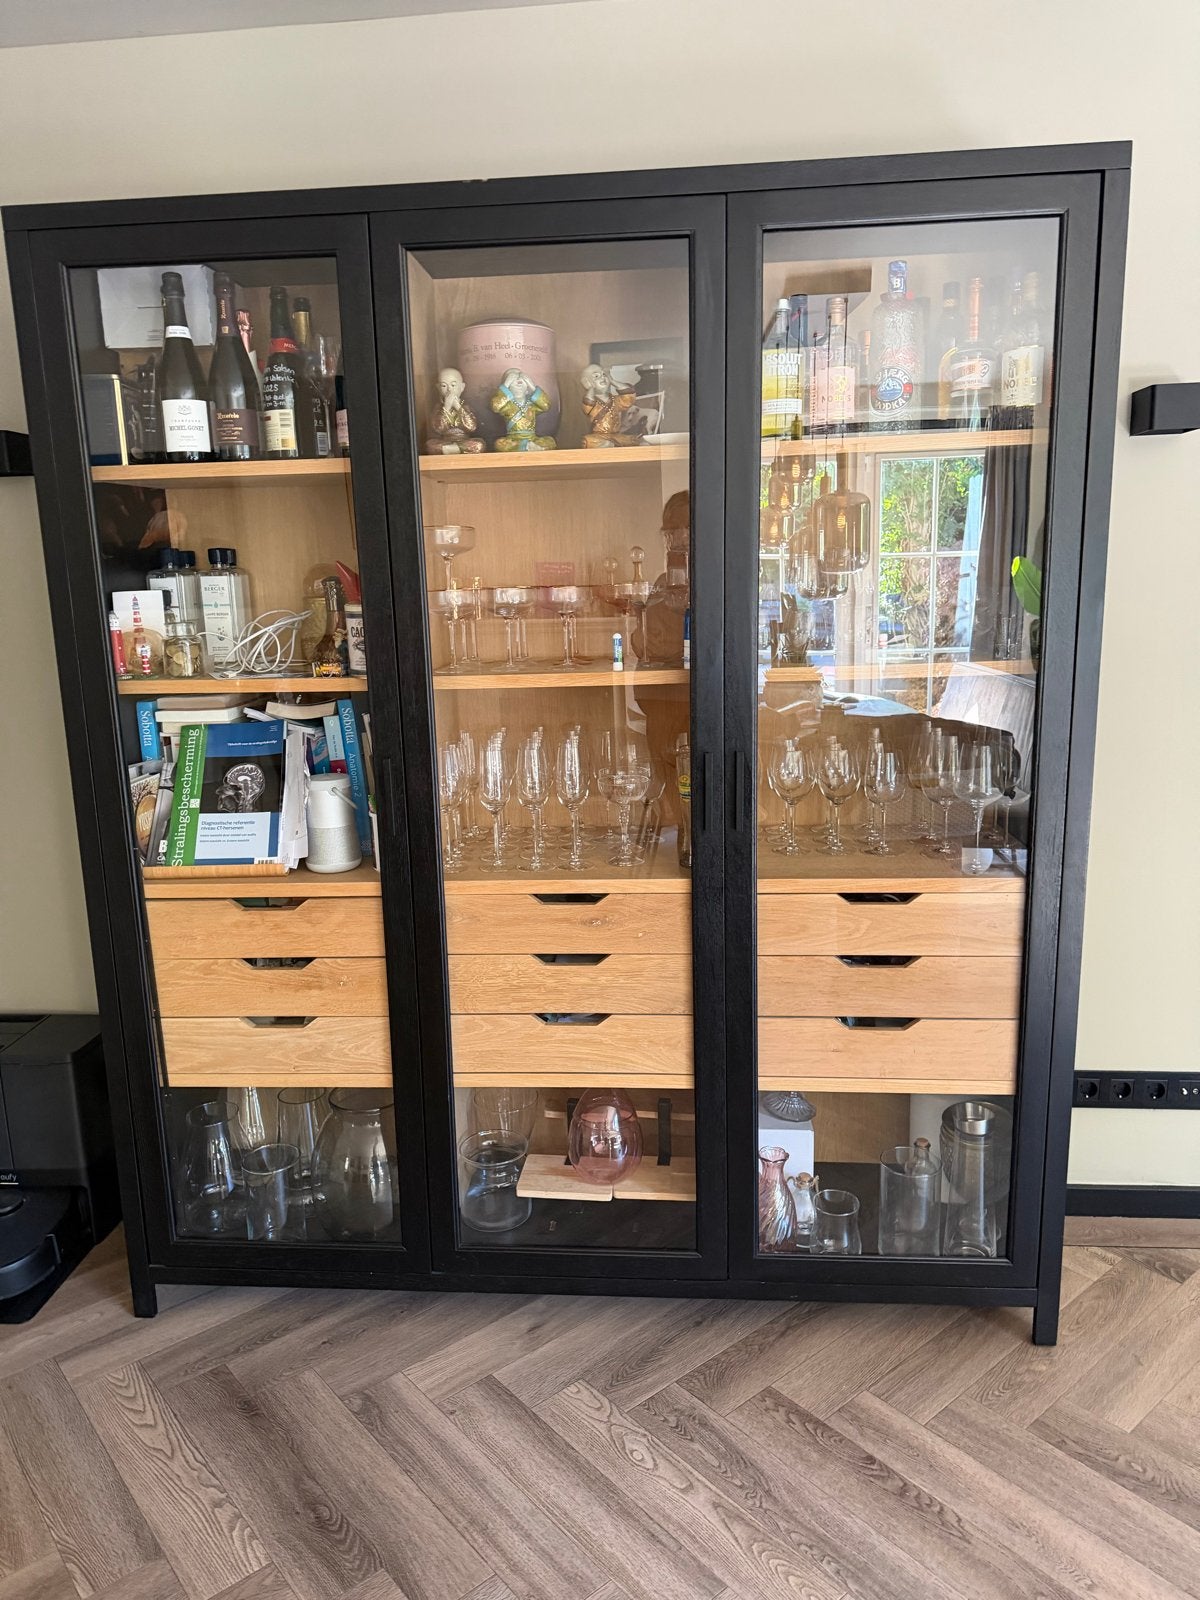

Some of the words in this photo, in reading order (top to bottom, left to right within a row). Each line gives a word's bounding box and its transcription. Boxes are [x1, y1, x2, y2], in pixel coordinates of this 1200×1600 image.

[140, 710, 153, 747] Sobotta
[341, 707, 355, 744] Sobotta
[347, 752, 359, 789] Anatomie
[172, 728, 200, 867] Stralingsbescherming
